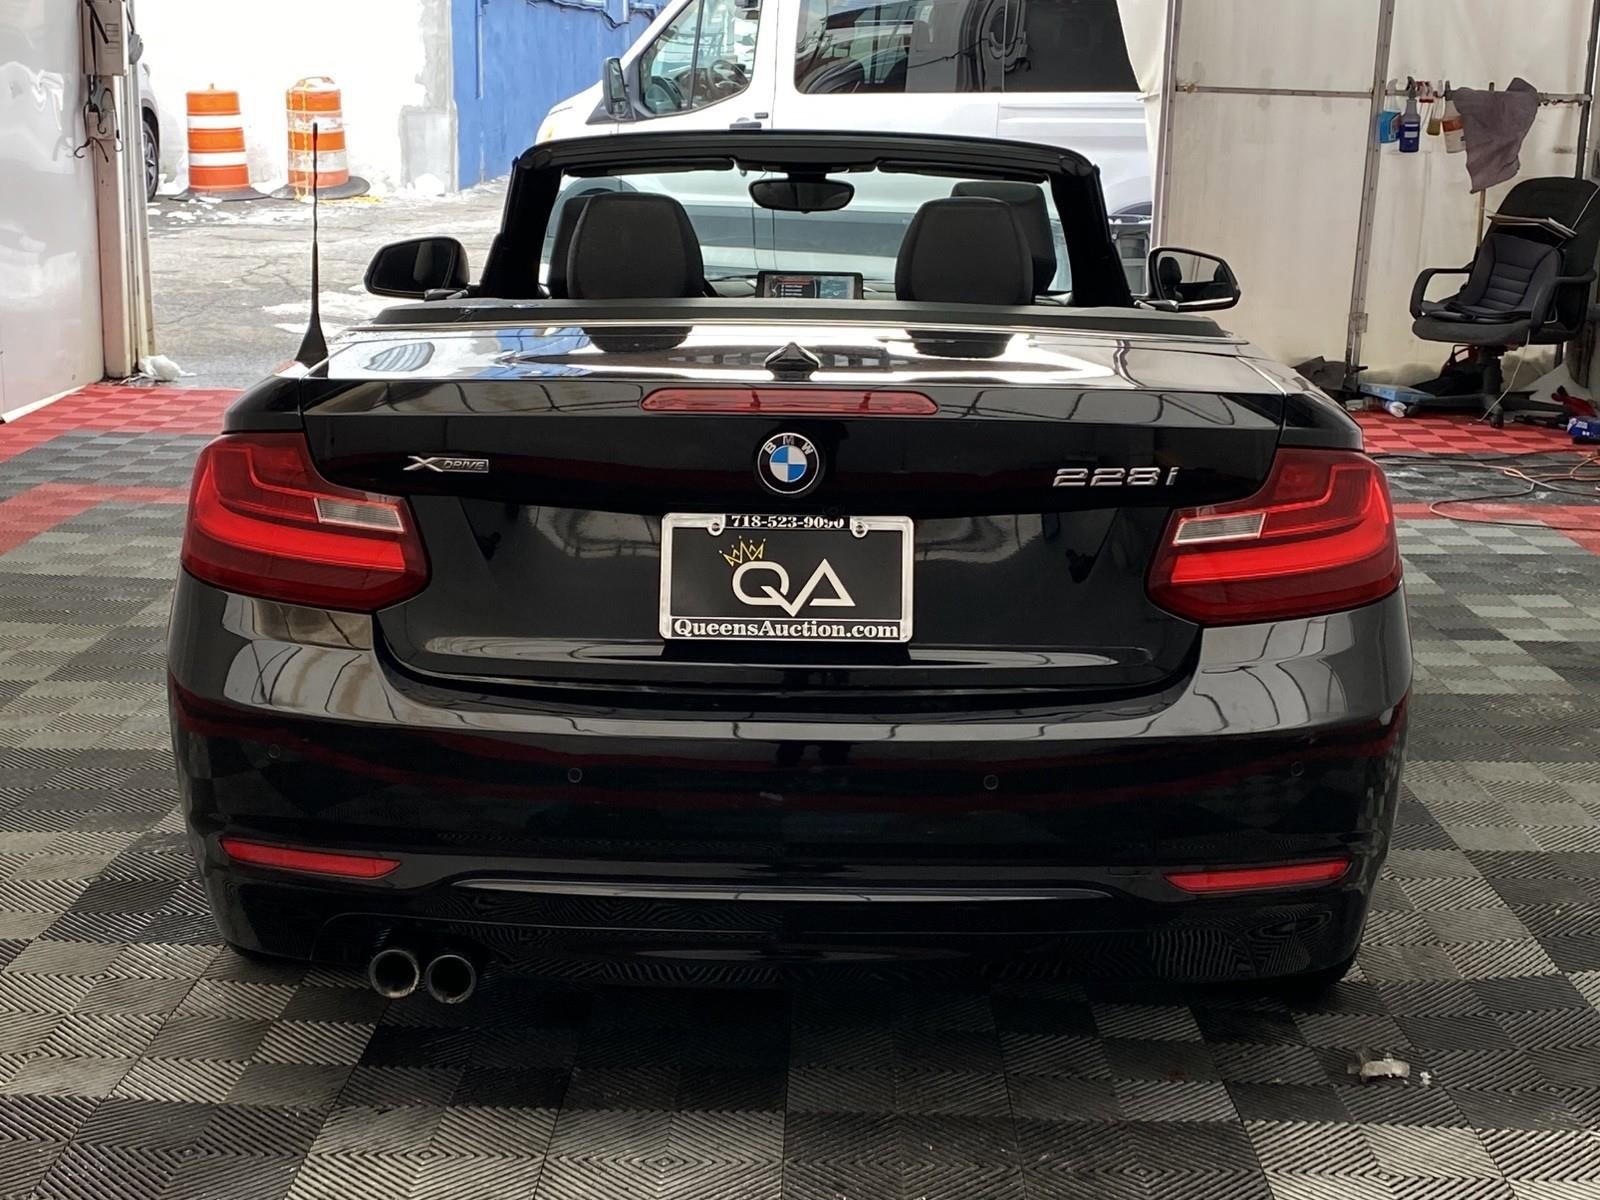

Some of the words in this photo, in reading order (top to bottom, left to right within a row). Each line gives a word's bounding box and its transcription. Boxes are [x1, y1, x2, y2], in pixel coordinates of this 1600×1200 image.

[764, 435, 814, 455] BMW
[1053, 467, 1180, 487] 228i
[674, 619, 899, 638] QueensAuction.com
